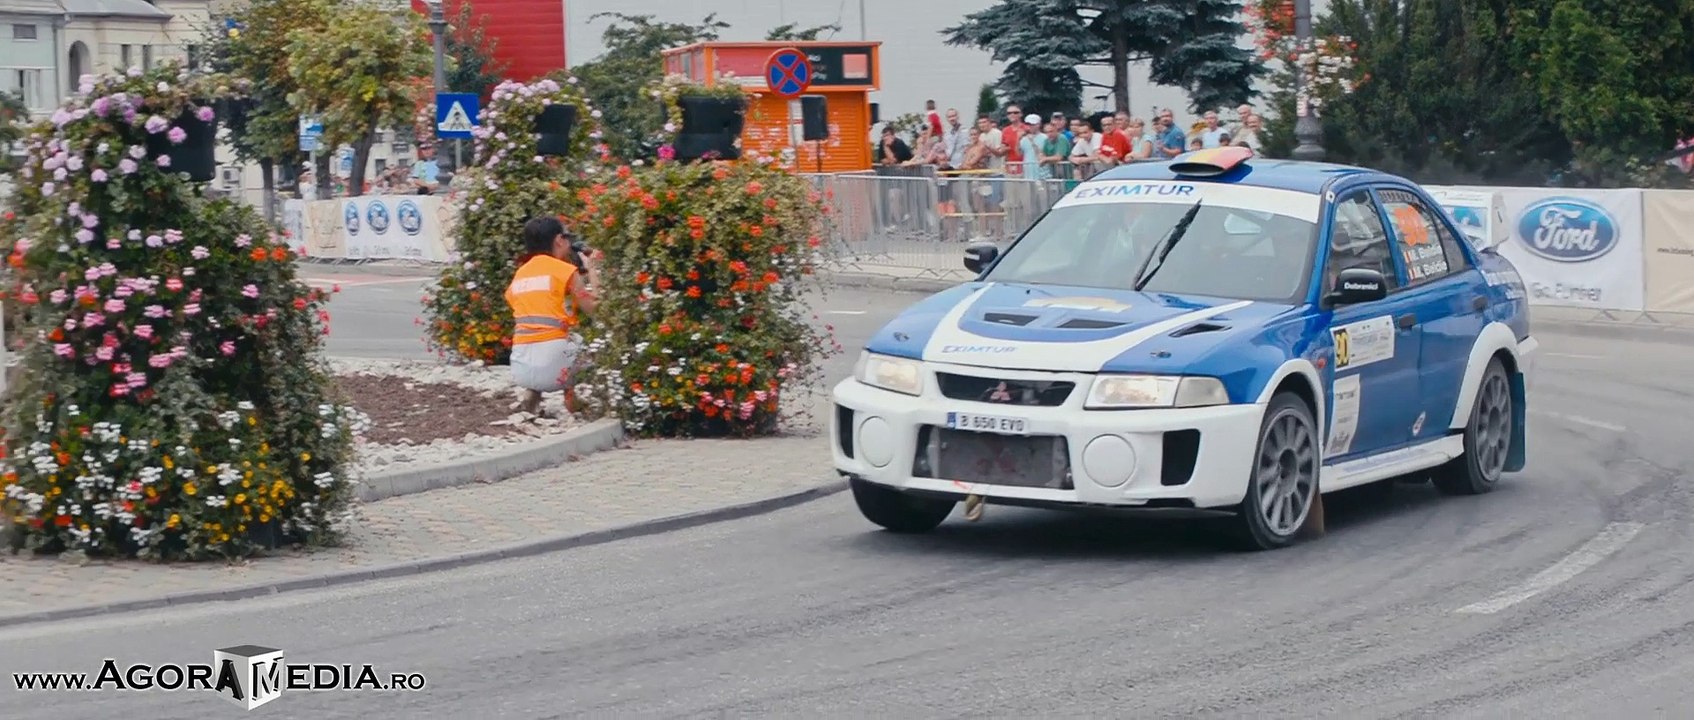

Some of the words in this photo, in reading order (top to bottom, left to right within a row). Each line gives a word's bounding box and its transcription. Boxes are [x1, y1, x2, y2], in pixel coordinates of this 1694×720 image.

[1074, 184, 1194, 200] EXIMTUR
[1533, 206, 1600, 251] Ford
[941, 345, 1016, 354] EXIMTUR
[1336, 332, 1349, 365] 90
[960, 415, 969, 427] B
[1001, 418, 1025, 432] EVO
